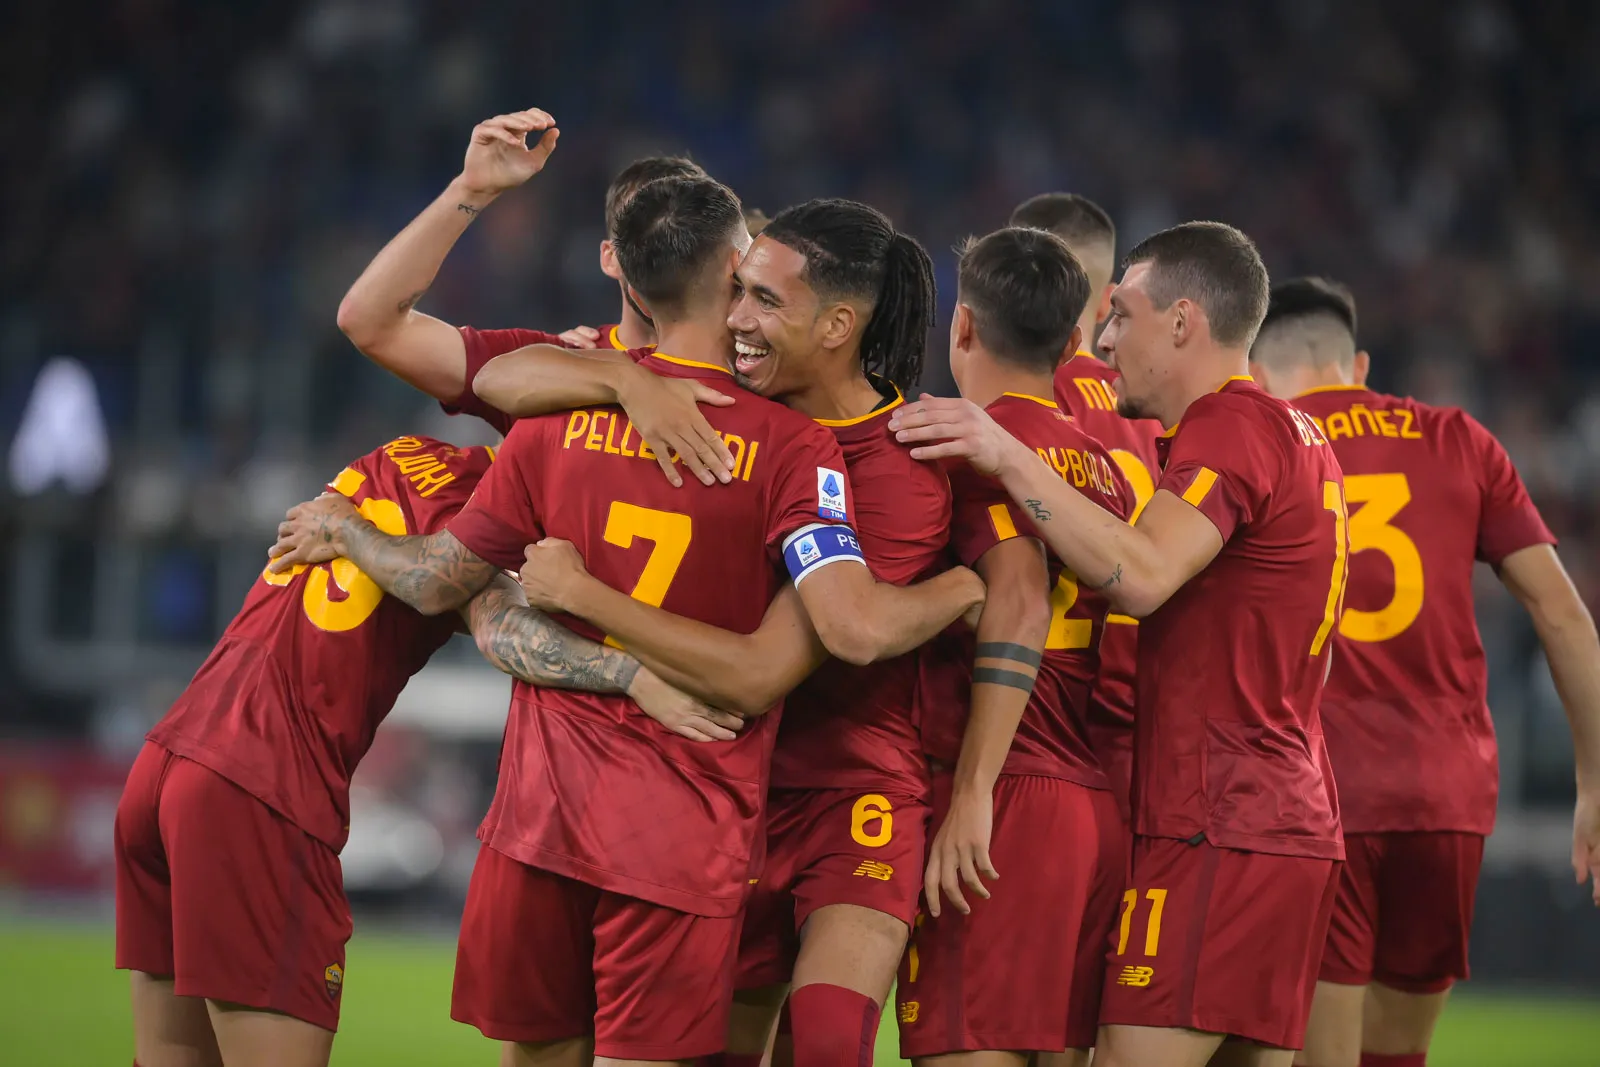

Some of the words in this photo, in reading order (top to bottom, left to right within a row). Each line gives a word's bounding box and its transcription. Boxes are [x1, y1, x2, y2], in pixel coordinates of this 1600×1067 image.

[563, 410, 760, 482] PELLNI
[603, 501, 692, 650] 7
[1338, 473, 1425, 643] 3
[850, 794, 893, 847] 6
[1117, 888, 1168, 957] 11
